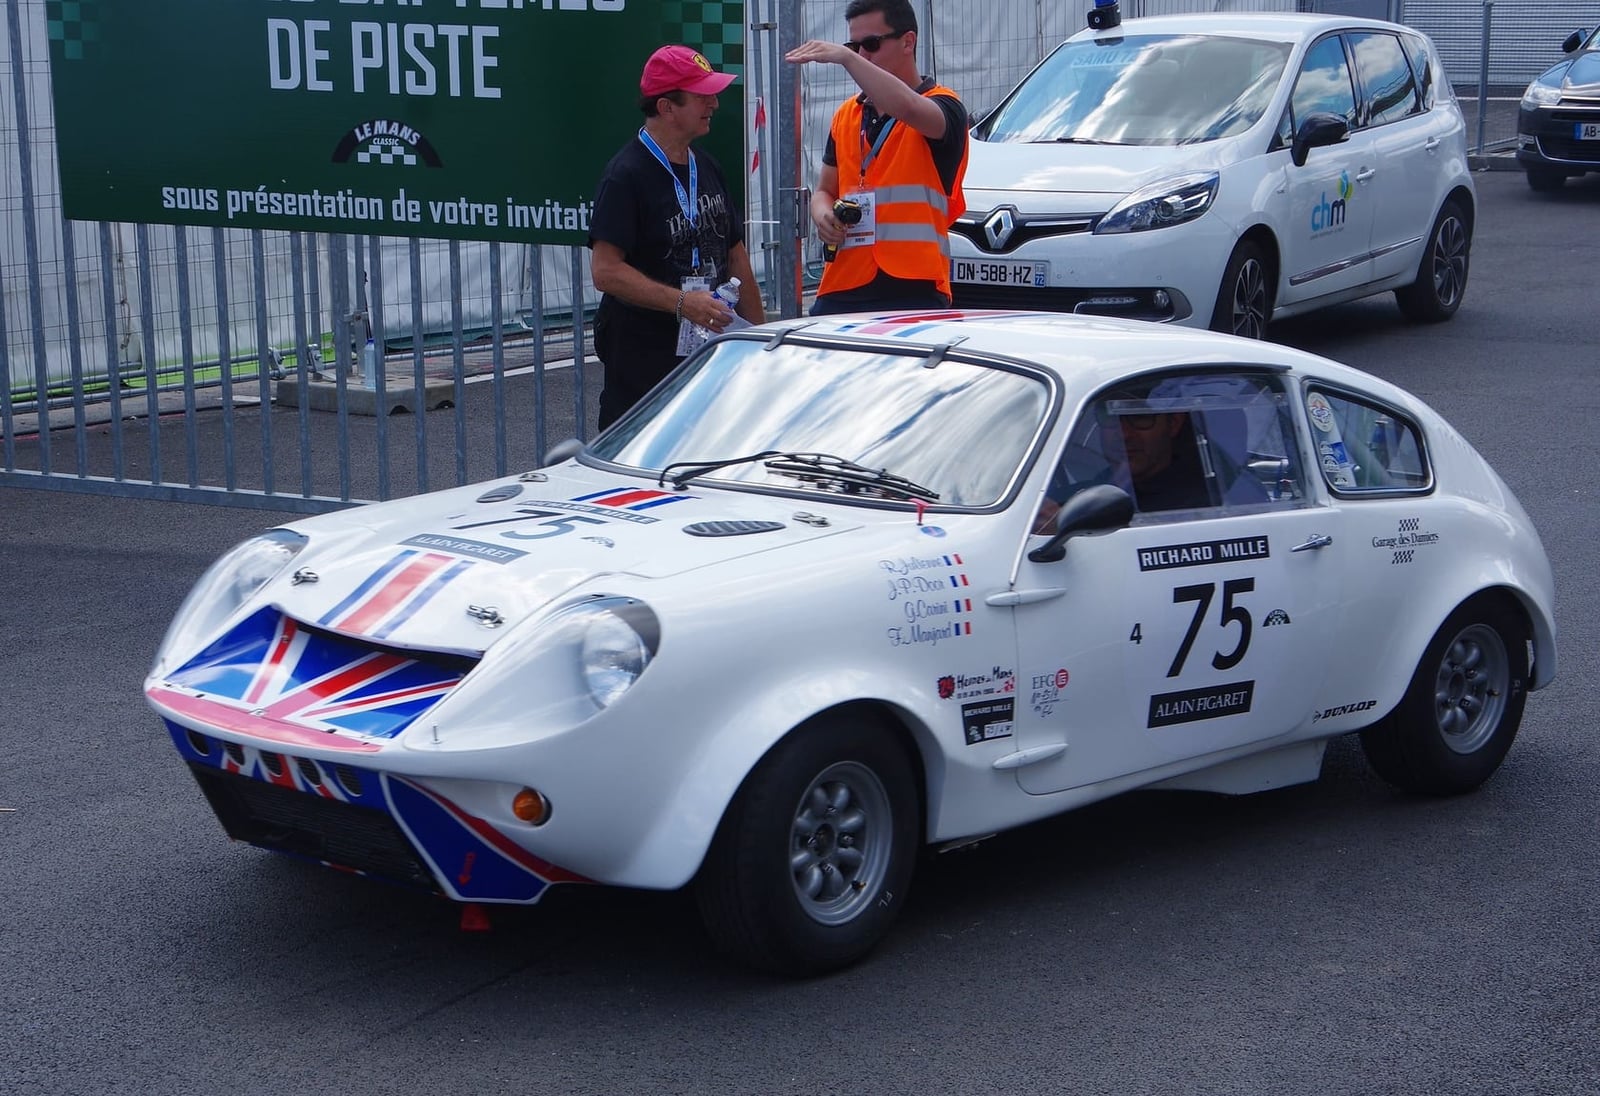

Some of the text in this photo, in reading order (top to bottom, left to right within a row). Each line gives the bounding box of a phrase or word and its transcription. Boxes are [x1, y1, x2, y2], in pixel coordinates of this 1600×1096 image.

[267, 18, 501, 98] DE PISTE
[354, 120, 421, 146] LE MANS
[373, 137, 399, 146] CLASSIC
[162, 186, 219, 211] sous
[226, 185, 384, 220] présentation
[391, 188, 421, 222] de
[428, 197, 498, 226] votre
[1311, 191, 1346, 231] chm
[957, 262, 1032, 284] DN-588-HZ
[450, 508, 610, 540] 75
[415, 536, 455, 549] ALAIN
[1141, 540, 1267, 567] RICHARD MILLE
[1129, 623, 1143, 645] 4
[1166, 577, 1256, 678] 75
[1154, 690, 1249, 718] ALAIN FIGARET
[1321, 700, 1377, 719] DUNLOP
